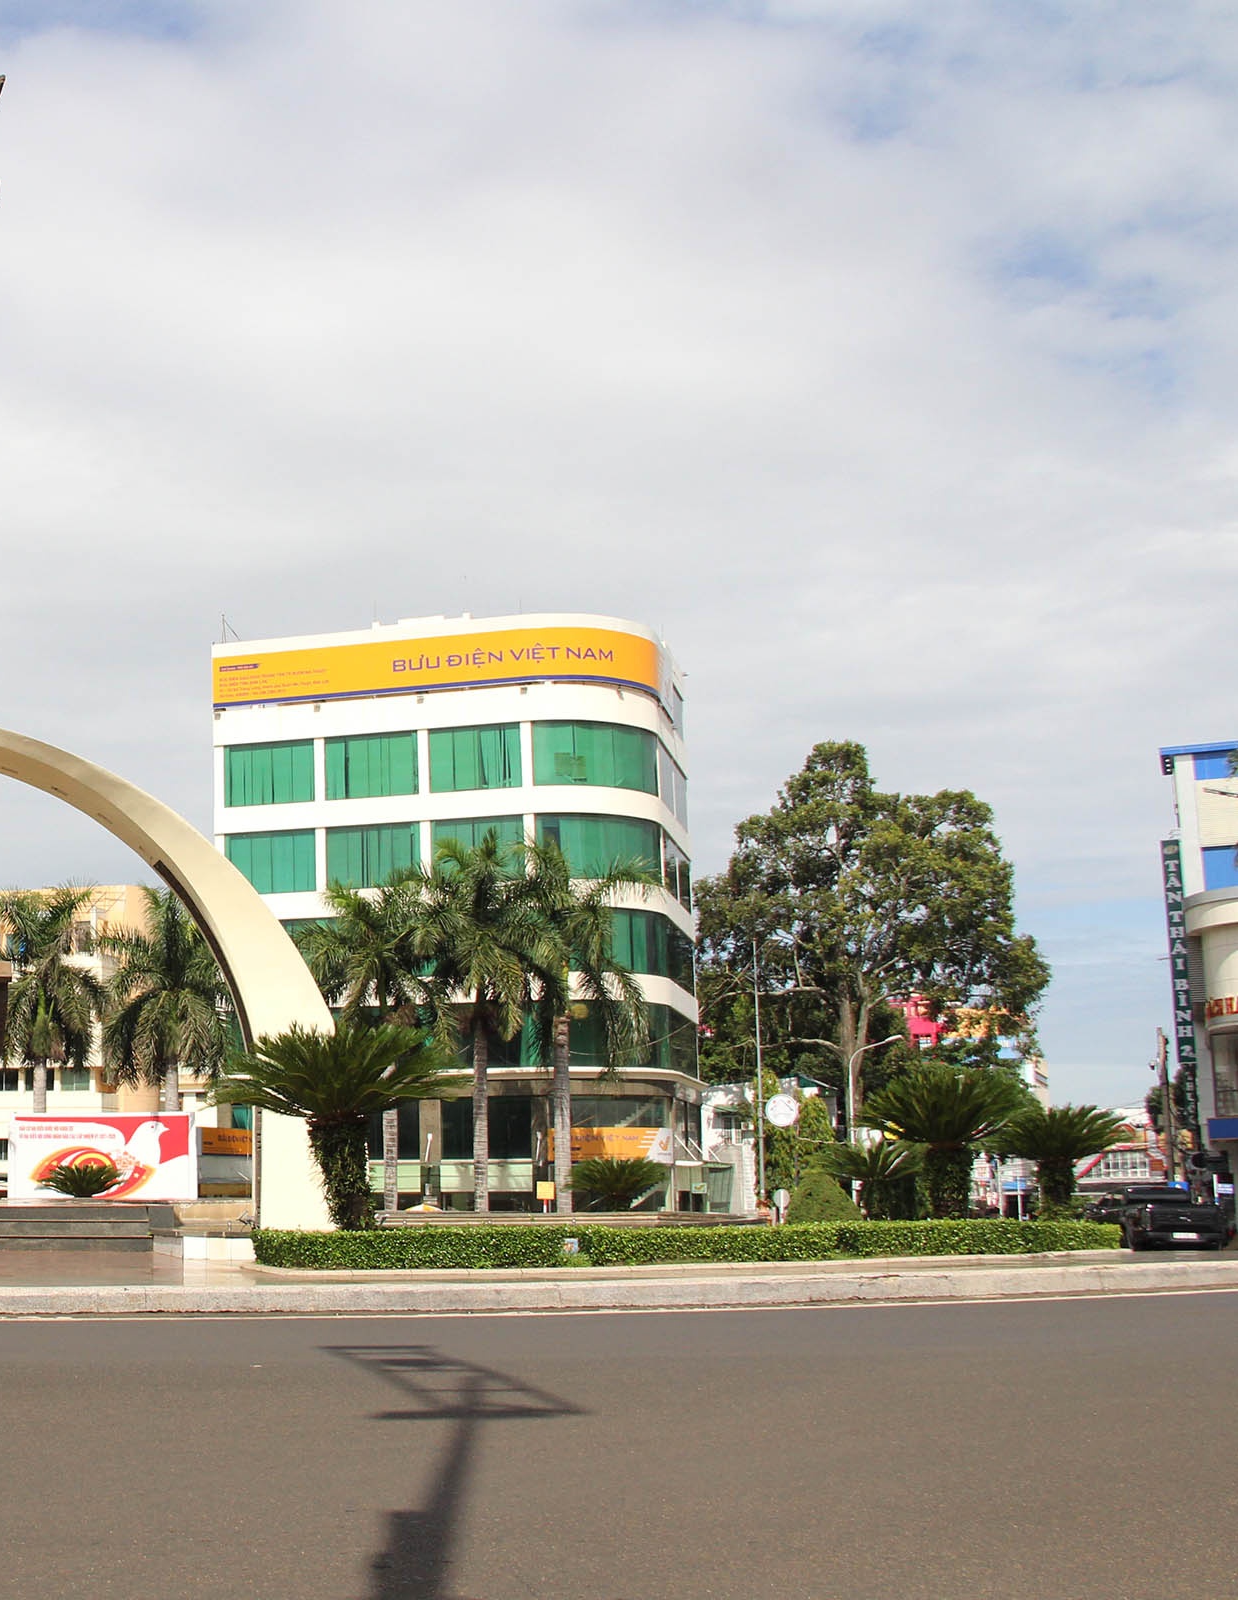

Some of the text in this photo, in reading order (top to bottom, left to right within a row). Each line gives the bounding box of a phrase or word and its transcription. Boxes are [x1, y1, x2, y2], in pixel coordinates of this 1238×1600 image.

[393, 642, 614, 672] BƯU ĐIỆN VIỆT NAM
[1164, 860, 1182, 903] TÂN
[1168, 911, 1187, 970] THÁI
[1174, 979, 1194, 1037] BÌNH
[1180, 1045, 1194, 1056] 2
